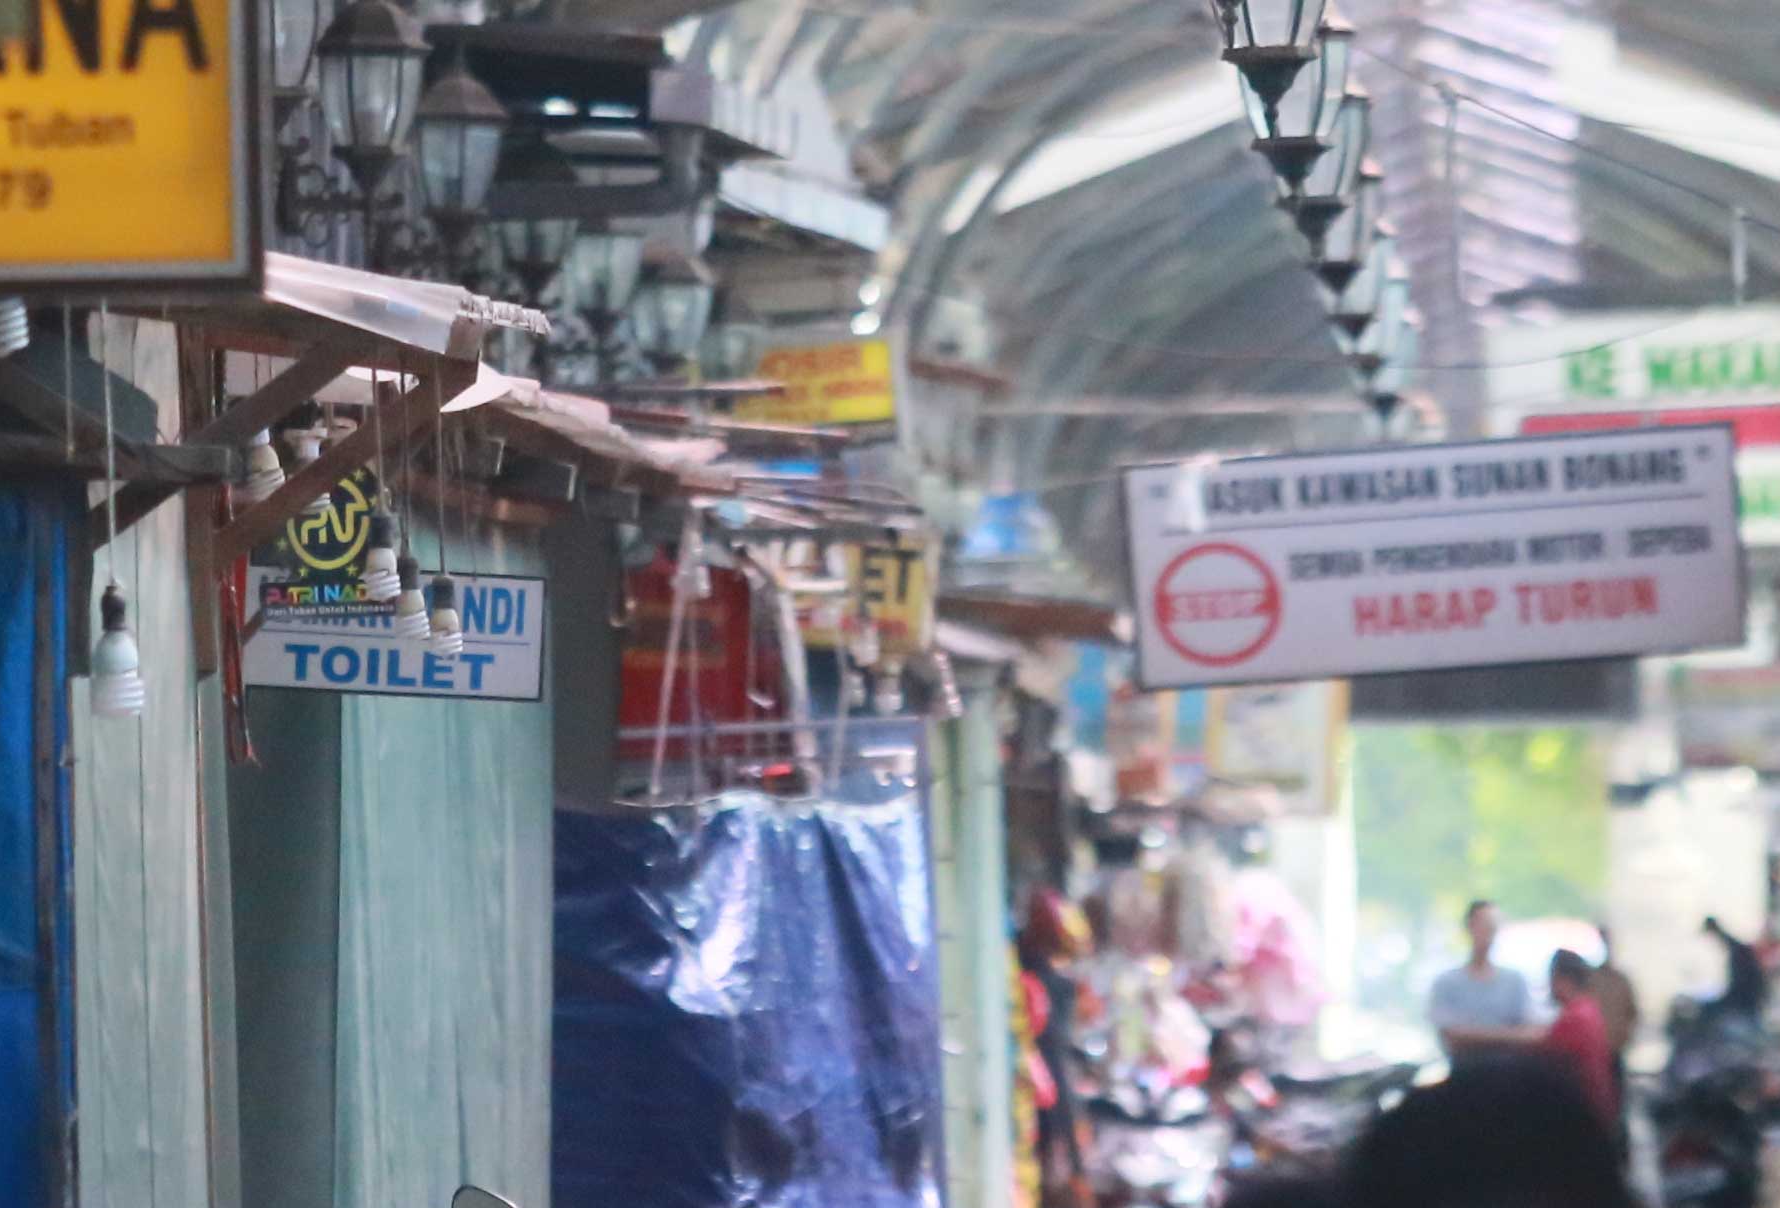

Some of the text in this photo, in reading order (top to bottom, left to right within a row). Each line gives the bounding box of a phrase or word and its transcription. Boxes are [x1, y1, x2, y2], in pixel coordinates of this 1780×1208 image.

[4, 107, 136, 150] Tuban
[1204, 447, 1688, 515] ASUK KAWASAN SUNAN BONANG
[1352, 574, 1660, 638] HARAP TURUN
[284, 641, 496, 692] TOILET
